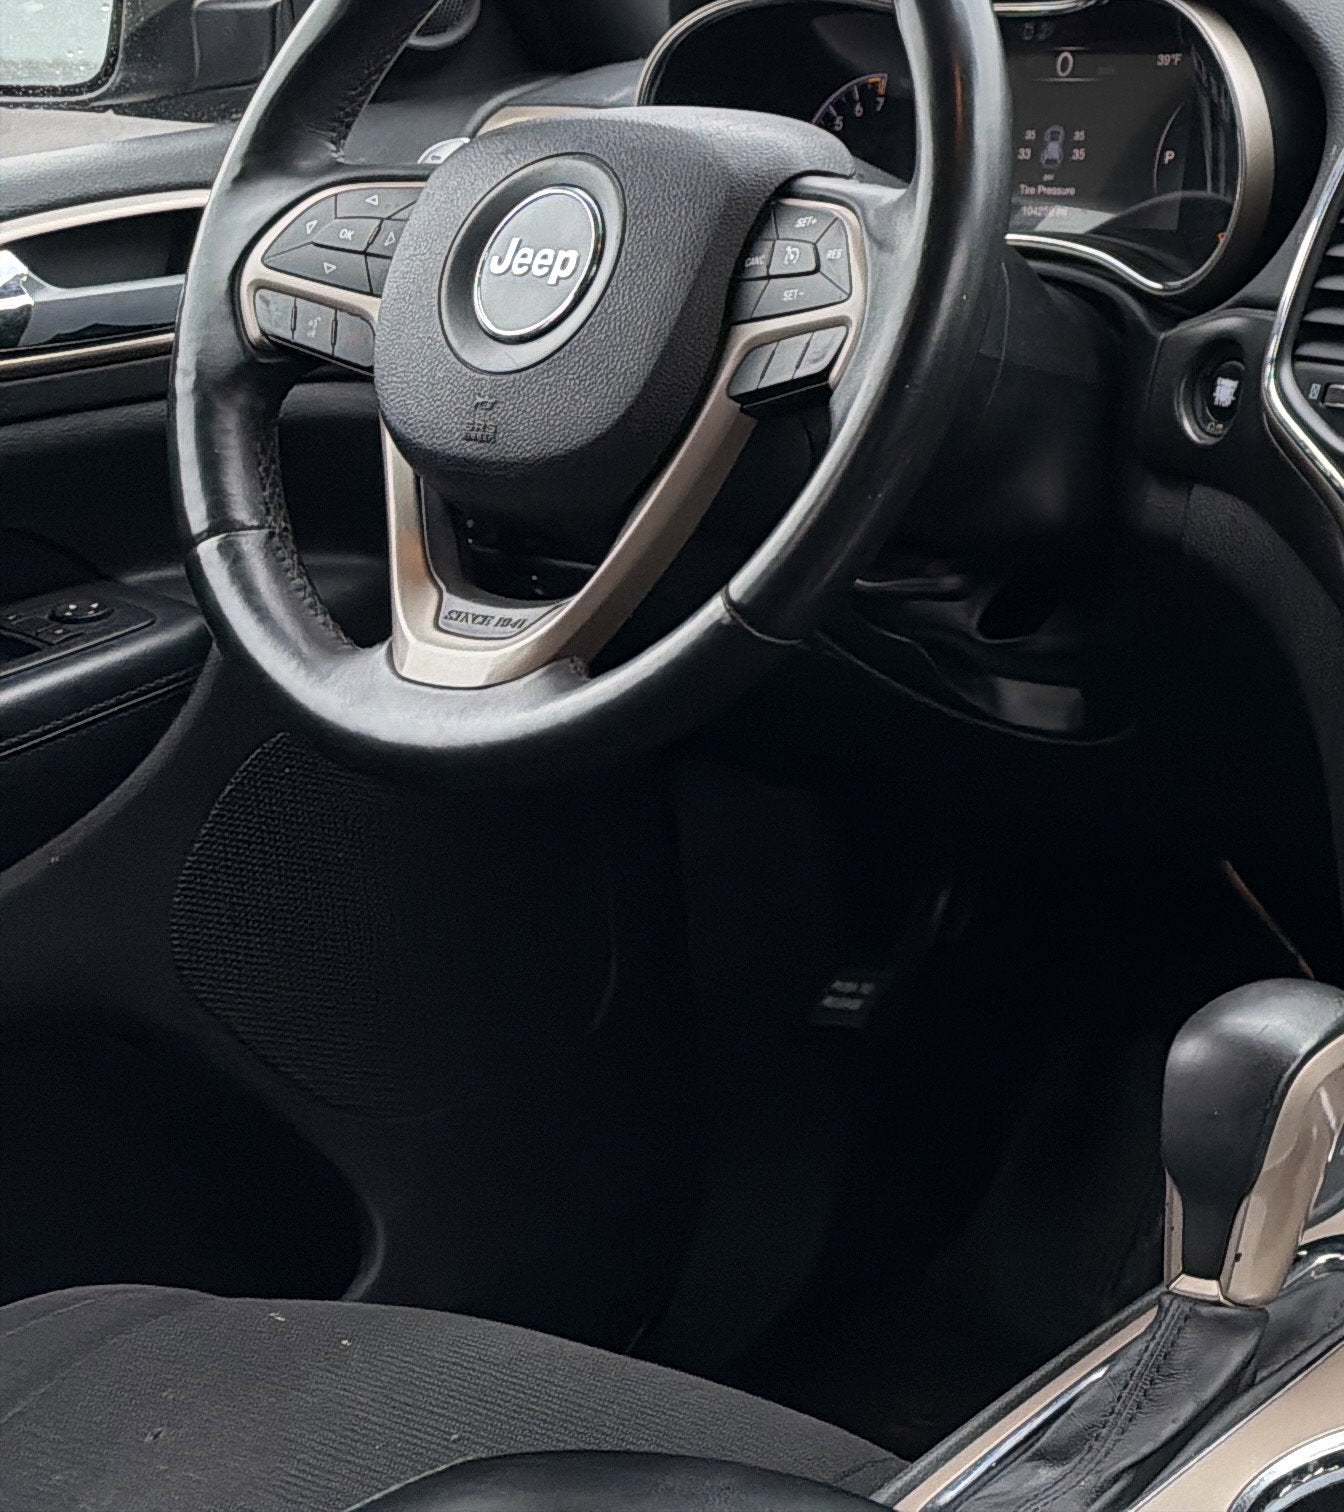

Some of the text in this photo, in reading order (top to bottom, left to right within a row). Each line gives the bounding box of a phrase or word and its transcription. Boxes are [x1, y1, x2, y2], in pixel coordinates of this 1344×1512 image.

[1056, 51, 1074, 77] 0
[855, 101, 863, 118] 6
[876, 96, 885, 112] 7
[1072, 148, 1086, 161] 35
[1164, 149, 1176, 165] P
[1019, 183, 1076, 196] Tire Pressure
[338, 228, 355, 241] OK
[489, 237, 579, 286] Jeep
